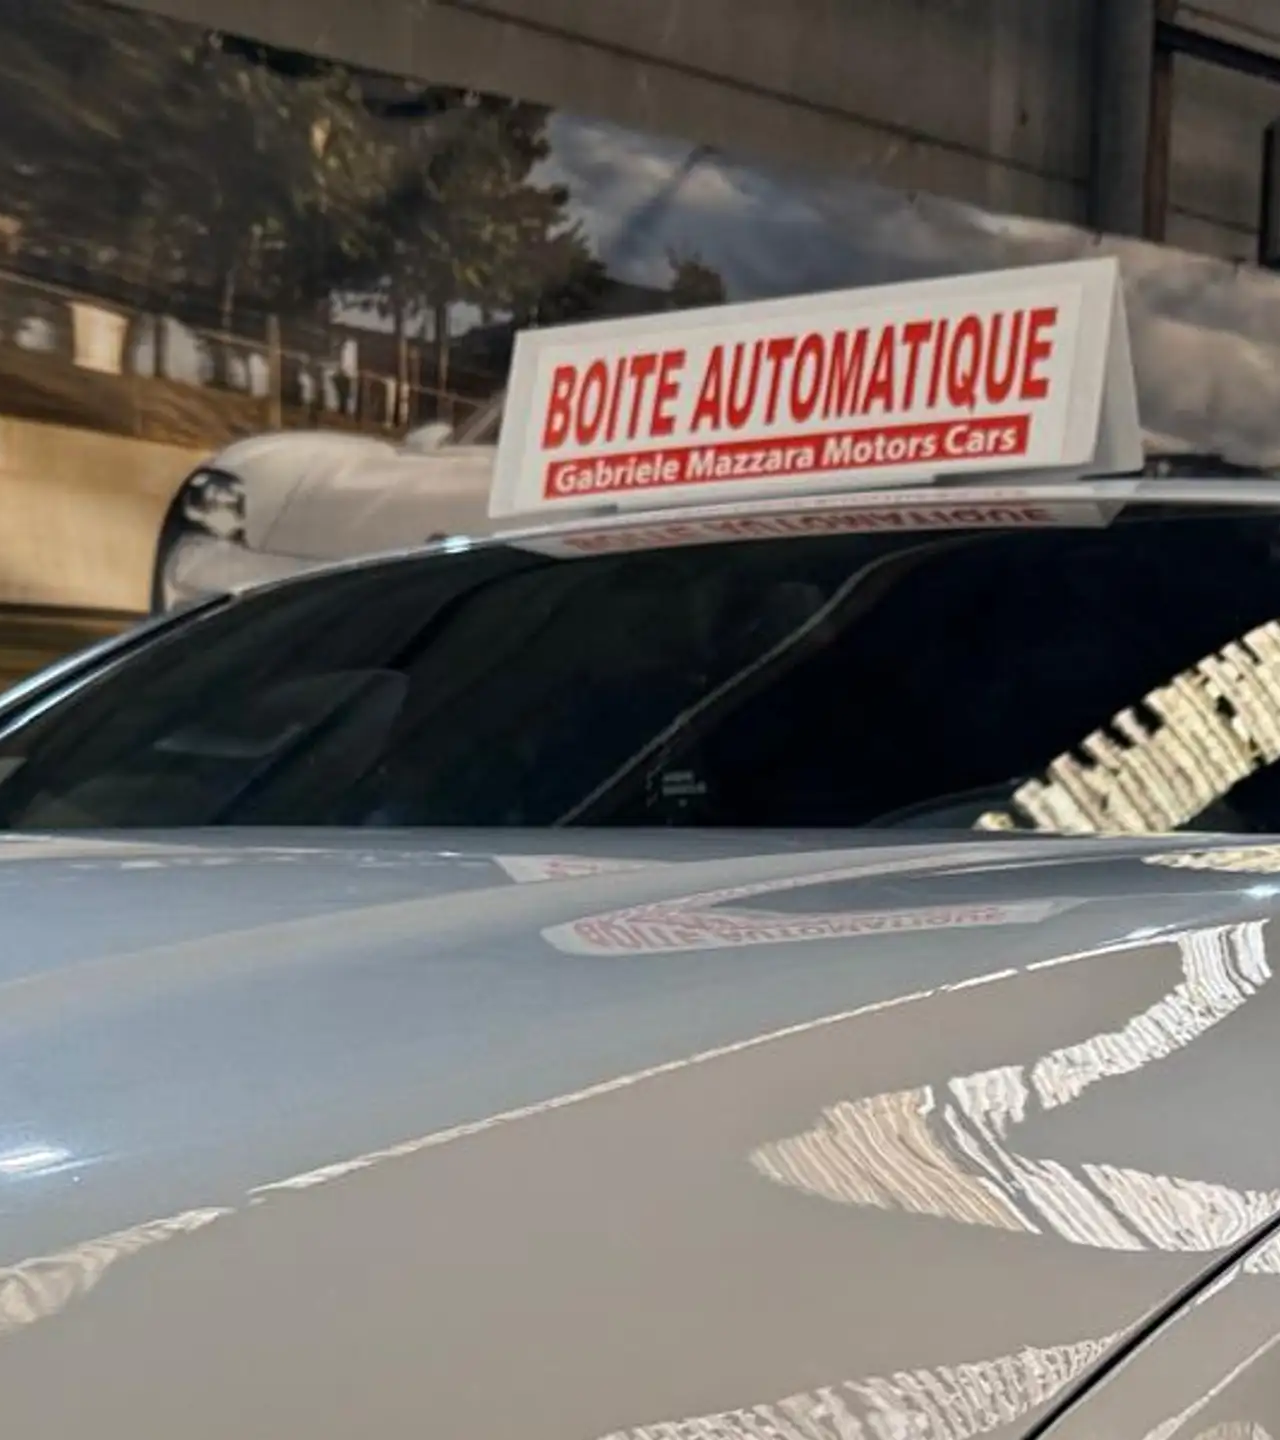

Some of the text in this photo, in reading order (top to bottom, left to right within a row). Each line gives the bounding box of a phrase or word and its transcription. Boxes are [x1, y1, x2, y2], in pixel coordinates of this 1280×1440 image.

[542, 307, 1058, 449] BOITE AUTOMATIQUE
[554, 455, 680, 497] Gabriele
[687, 444, 814, 480] Mazzara
[822, 430, 937, 465] Motors
[943, 421, 1018, 455] Cars
